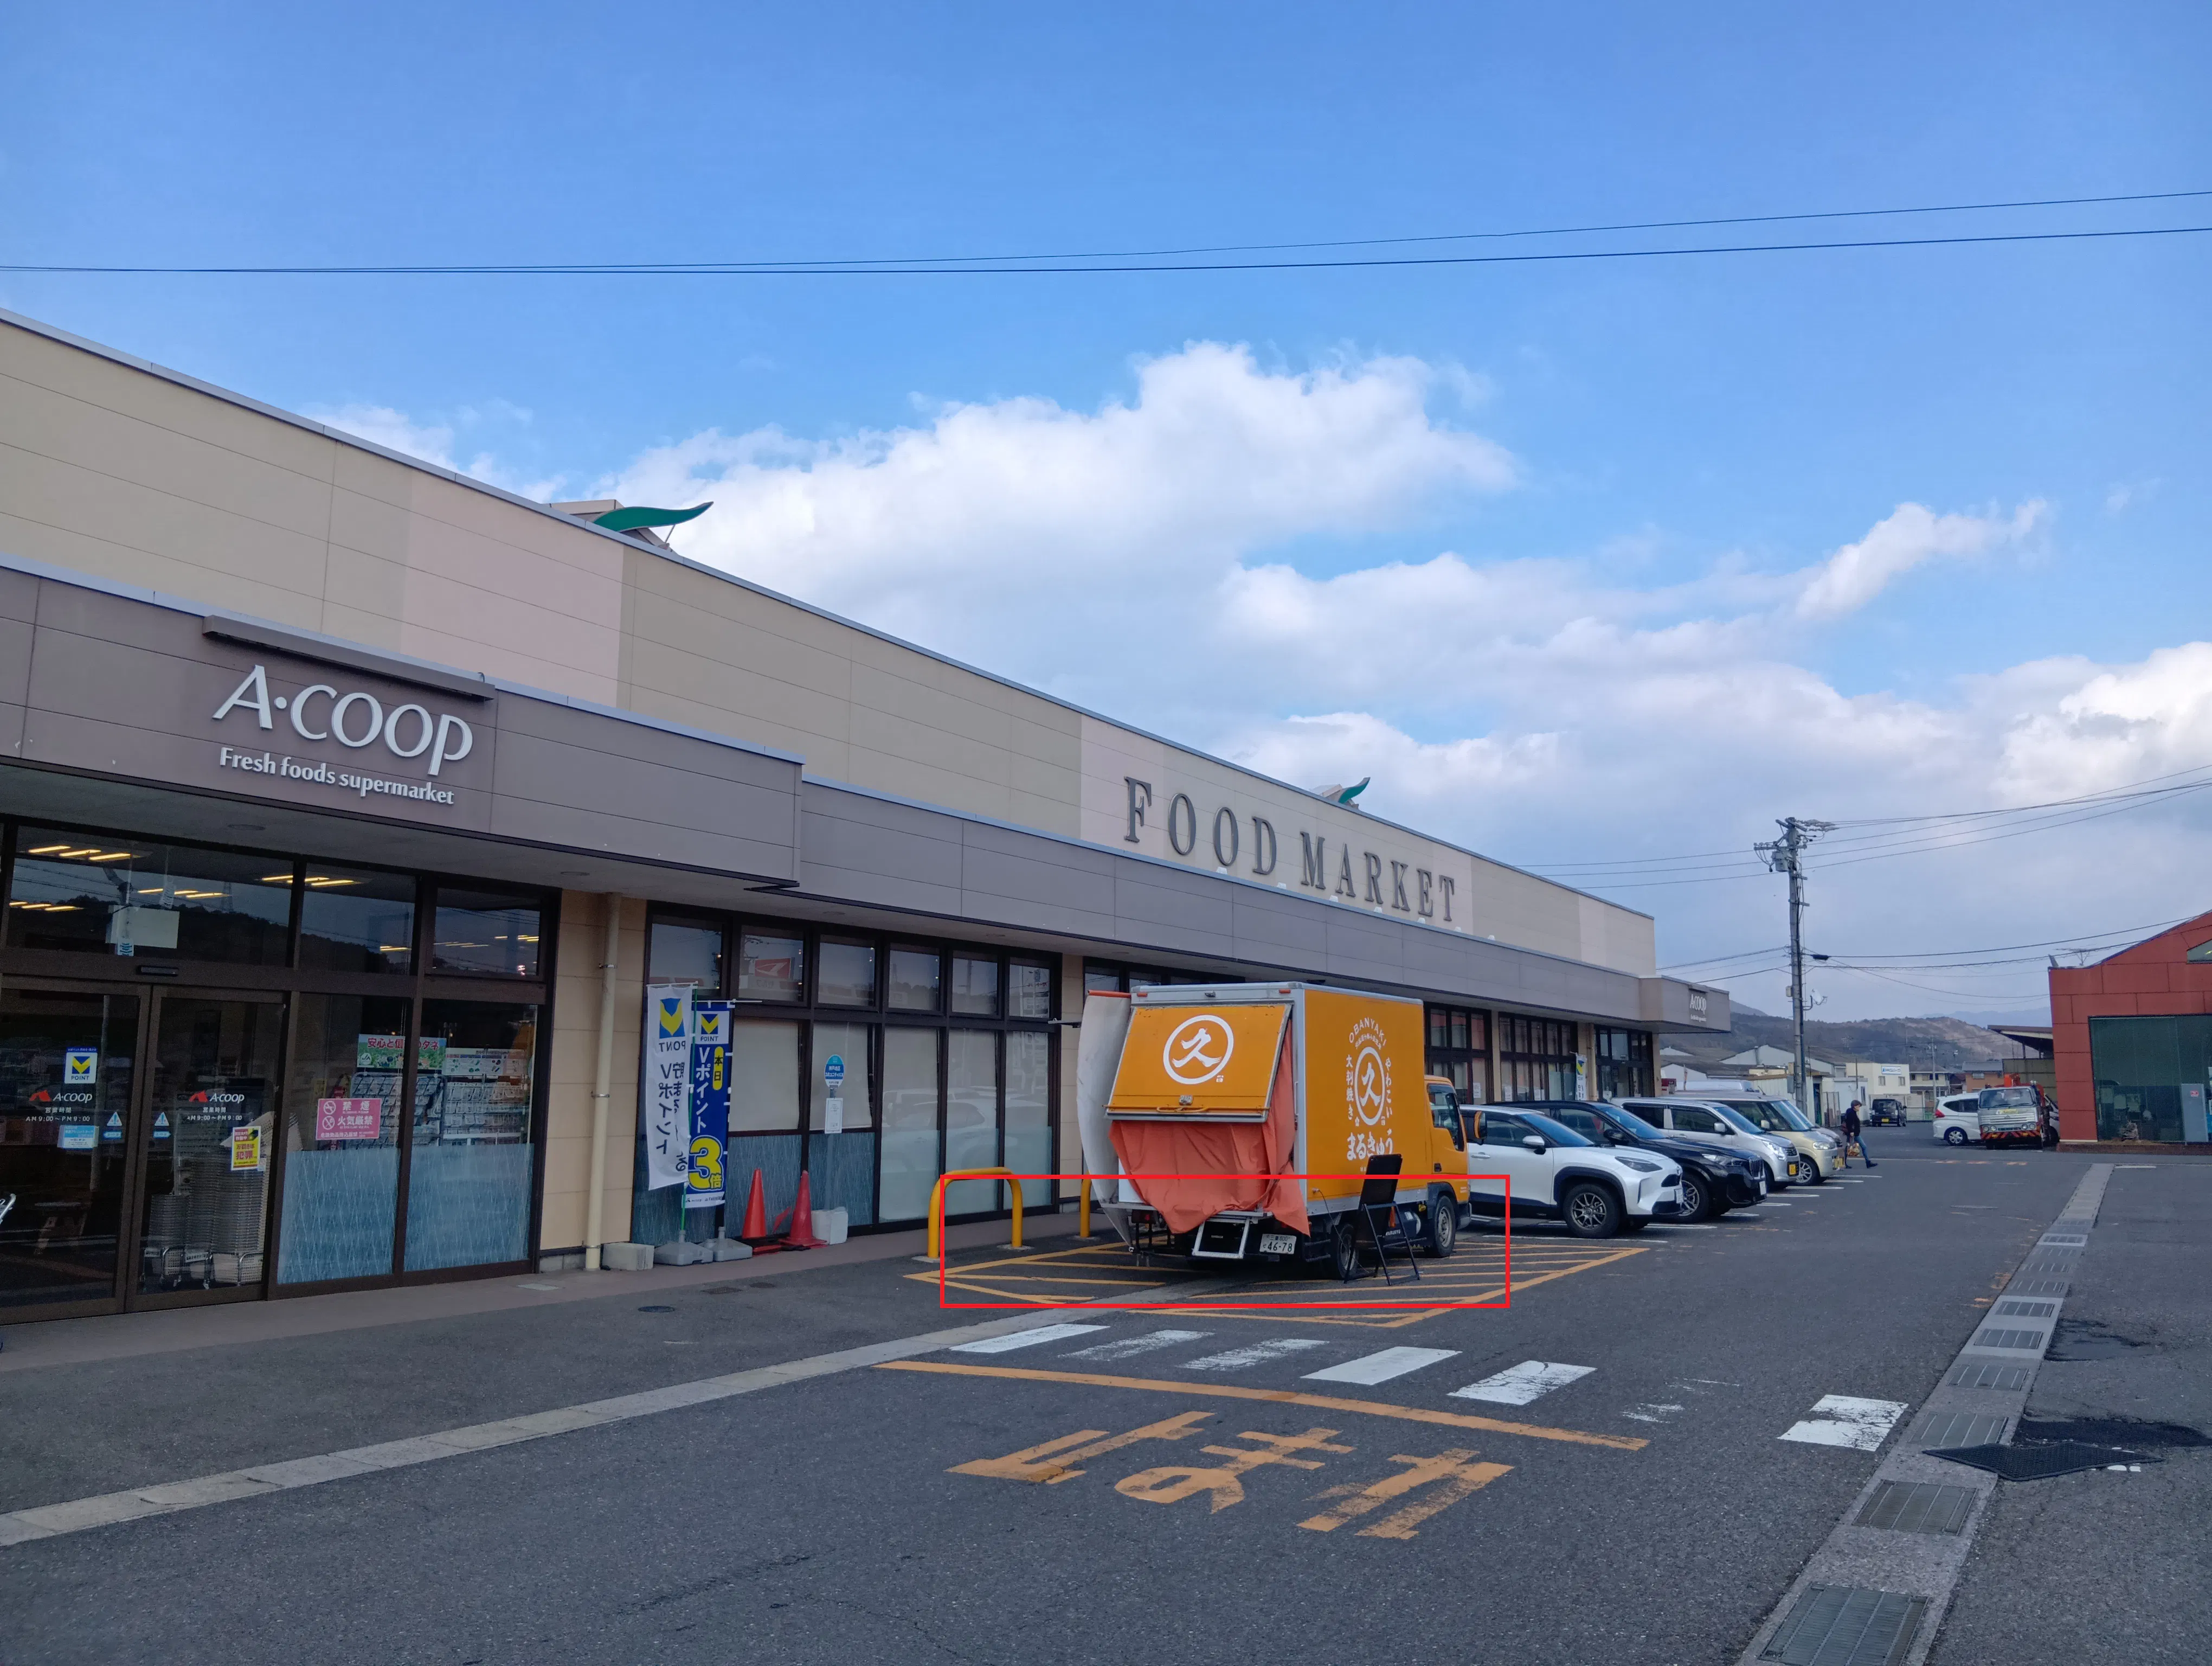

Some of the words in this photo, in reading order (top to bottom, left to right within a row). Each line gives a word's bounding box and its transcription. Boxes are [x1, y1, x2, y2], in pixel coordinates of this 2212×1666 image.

[219, 746, 276, 775] Fresh
[280, 755, 336, 784] foods
[338, 773, 455, 805] supermarket
[1123, 776, 1277, 875] FOOD
[1300, 831, 1455, 922] MARKET
[1171, 1028, 1223, 1068] 久
[1349, 1017, 1387, 1046] OBANYAKI
[713, 1055, 723, 1081] 本日
[1346, 1054, 1354, 1120] 大判焼き
[1385, 1057, 1393, 1119] やわこい
[696, 1047, 711, 1134] Vポイント
[337, 1115, 374, 1126] 火気厳禁
[1347, 1128, 1393, 1161] まるきゅう
[1267, 1241, 1293, 1252] 46-78
